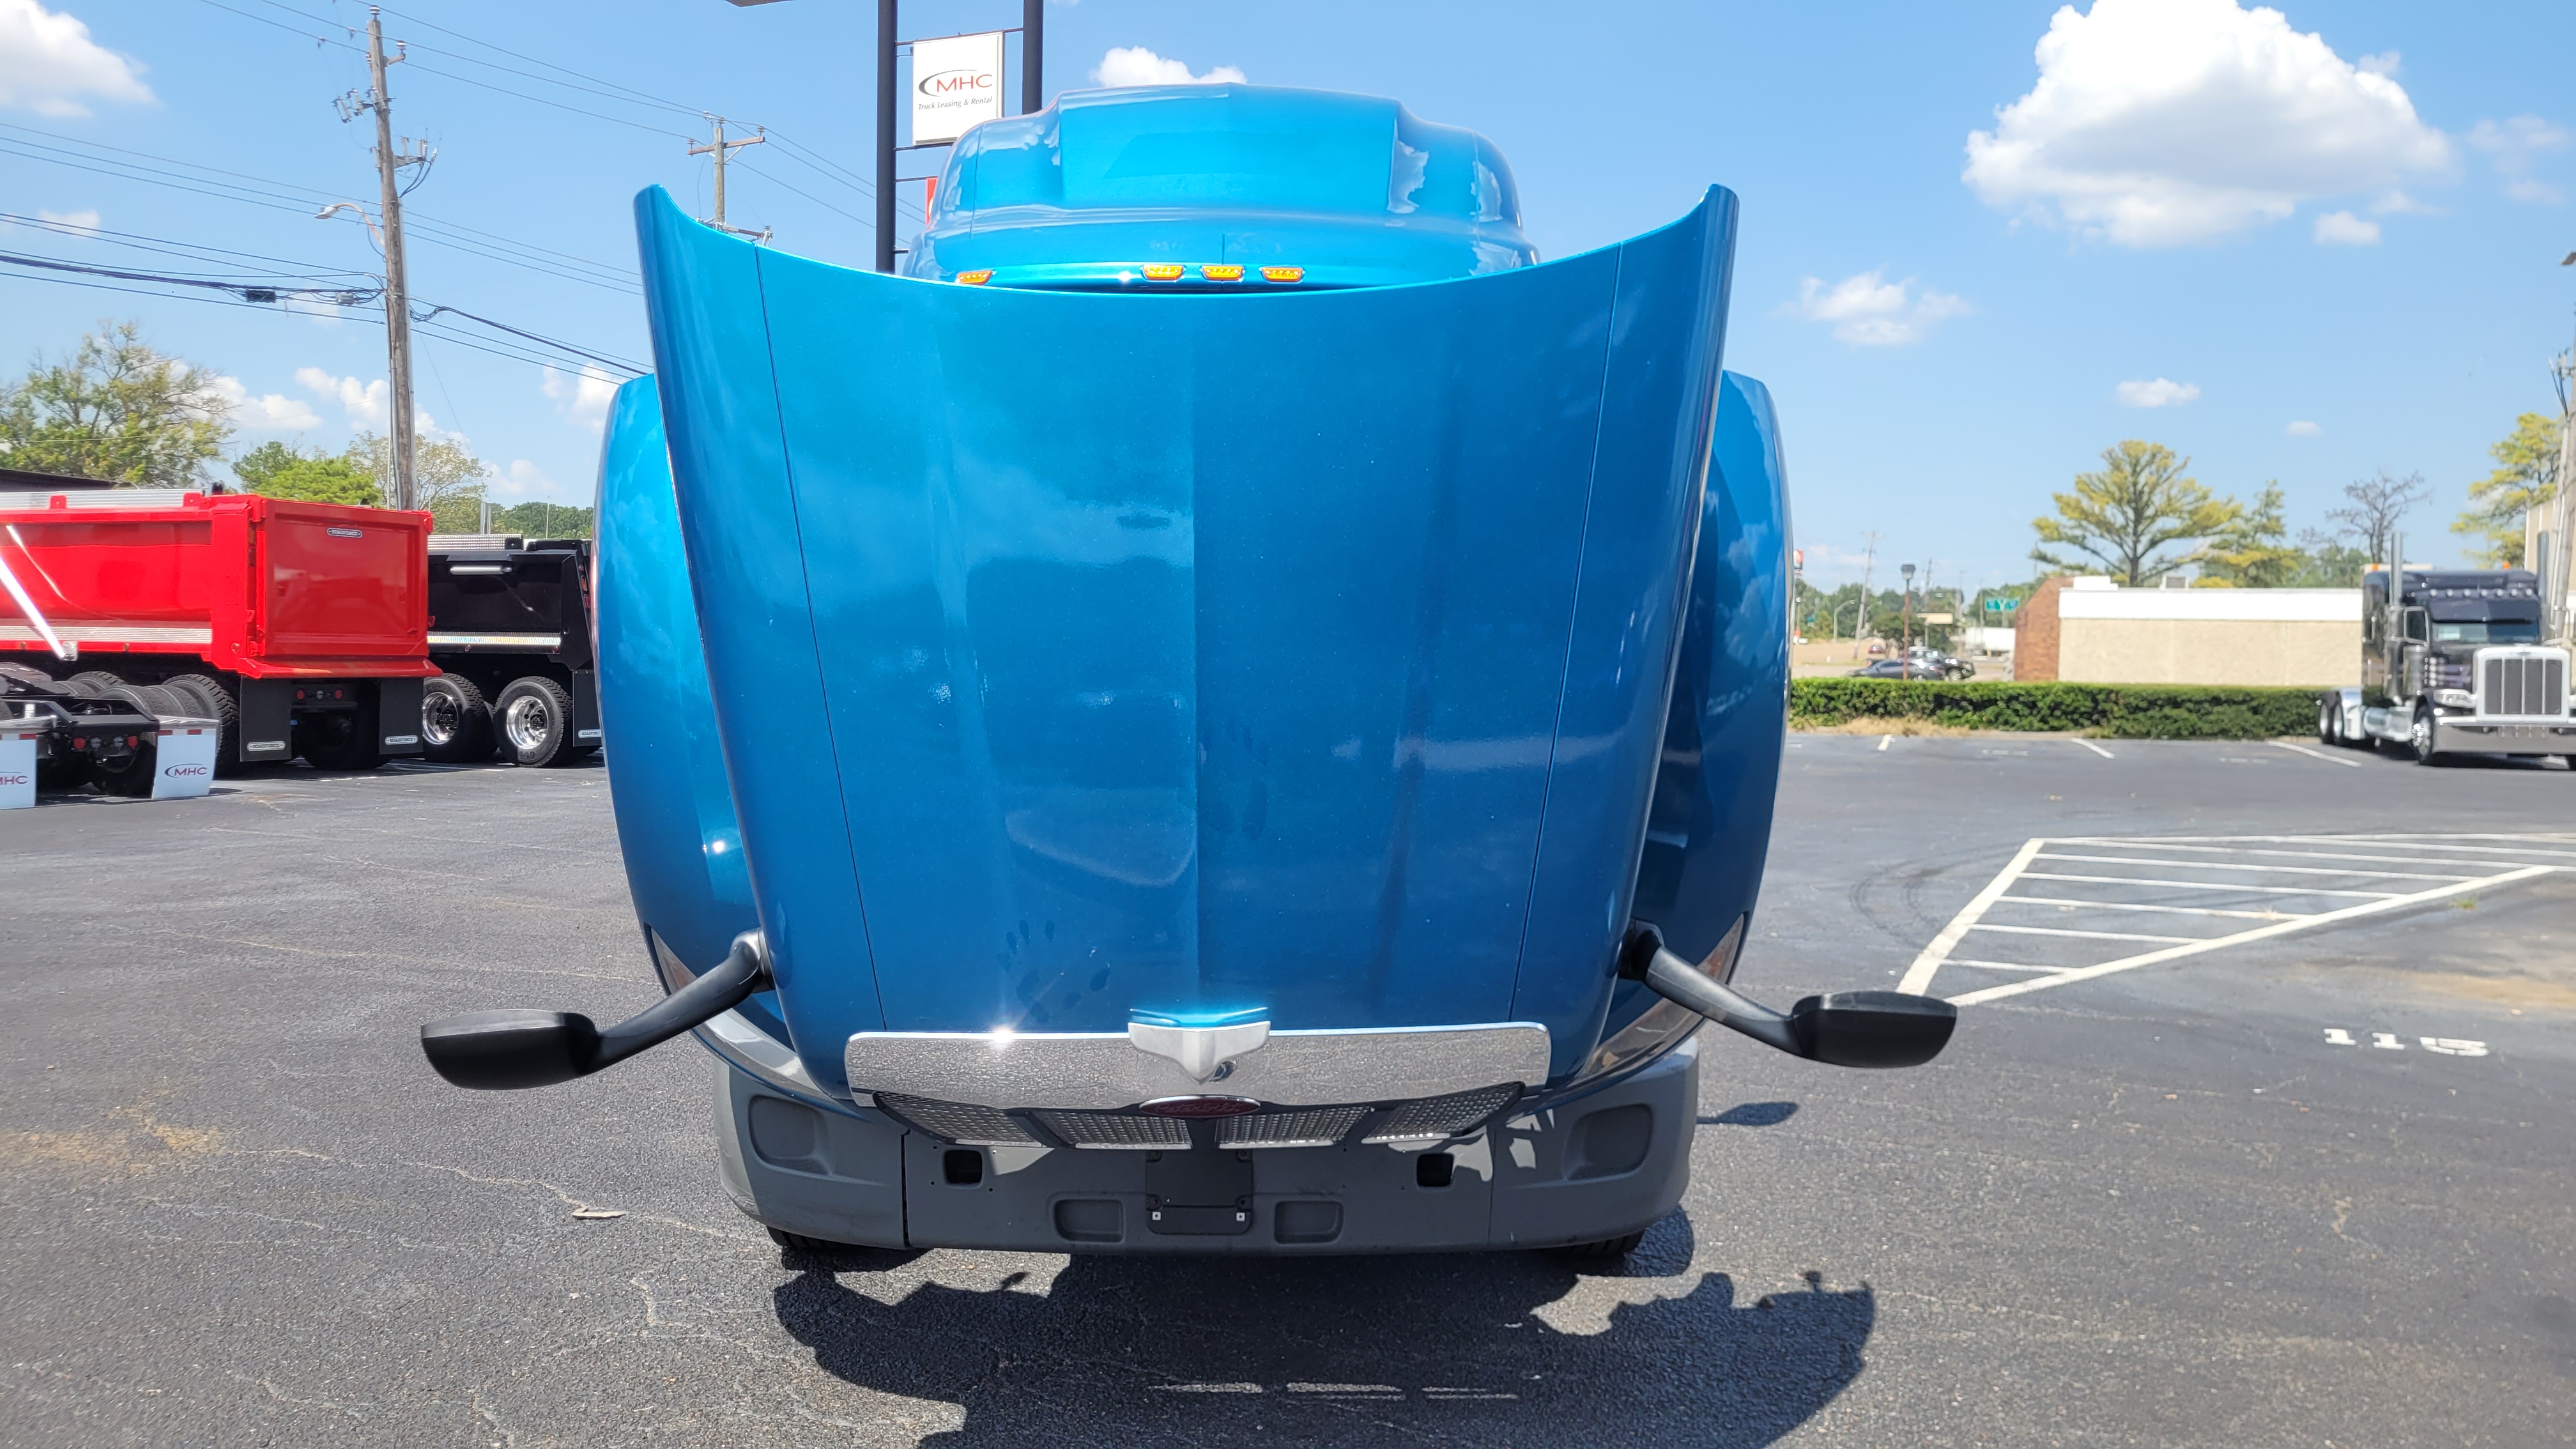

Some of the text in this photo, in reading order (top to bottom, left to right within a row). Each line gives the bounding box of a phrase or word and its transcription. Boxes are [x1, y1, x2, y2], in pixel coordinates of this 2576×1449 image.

[937, 74, 993, 93] MHC
[918, 102, 936, 111] Truck
[937, 100, 962, 109] Leasing
[971, 96, 993, 105] Rental
[174, 767, 208, 776] MHC
[0, 775, 28, 785] HC
[2324, 1028, 2490, 1057] 115
